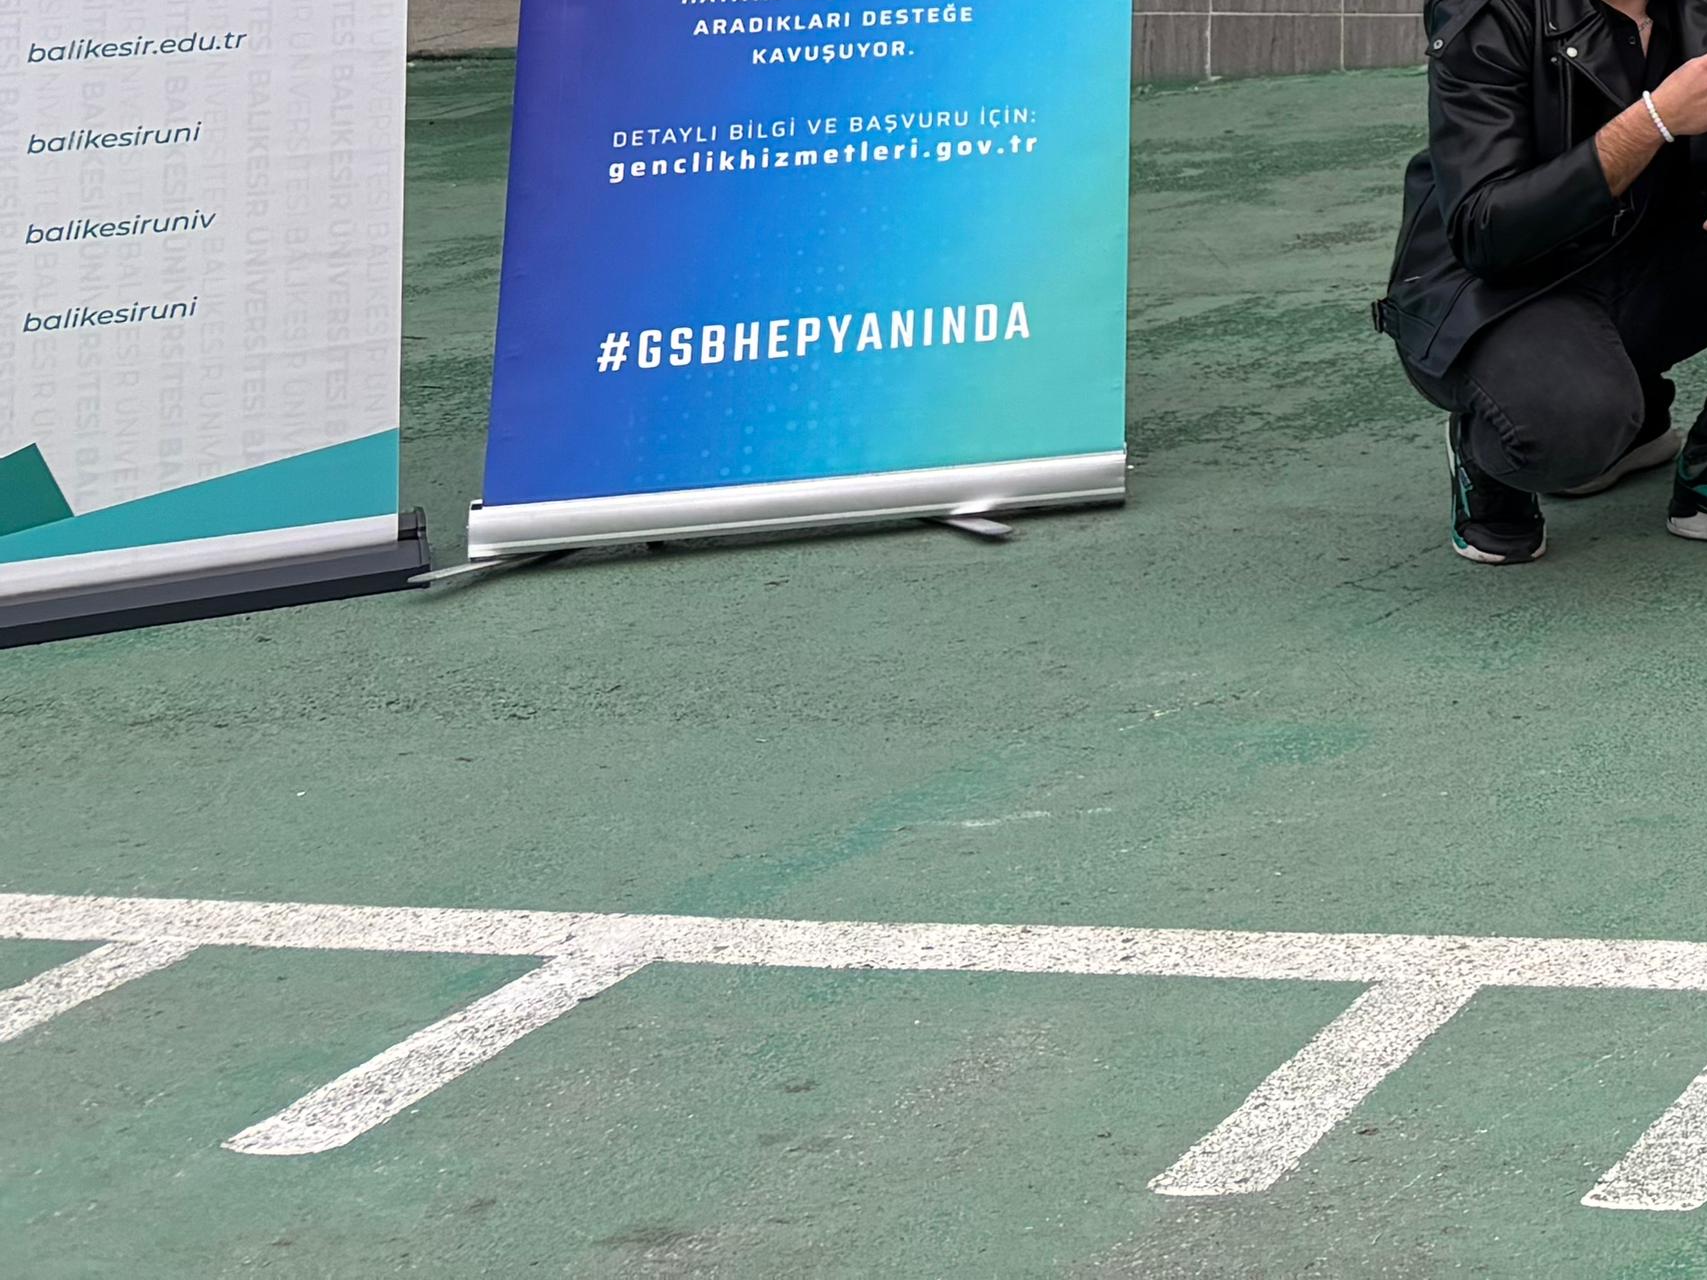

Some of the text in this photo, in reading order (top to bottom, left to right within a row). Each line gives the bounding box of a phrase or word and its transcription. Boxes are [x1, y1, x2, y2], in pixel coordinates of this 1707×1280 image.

[693, 4, 973, 35] ARADIKLARI DESTEĞE
[27, 30, 247, 64] balikesir.edu.tr
[752, 41, 914, 64] KAVUŞUYOR.
[27, 121, 202, 155] balikesiruni
[612, 104, 1037, 148] DETAYLI BİLGİ VE BAŞVURU İÇİN:
[608, 135, 1038, 184] genclikhizmetleri.gov.tr
[25, 210, 217, 245] balikesiruniv
[22, 296, 198, 333] balikesiruni
[597, 301, 1031, 373] #GSBHEPYANINDA
